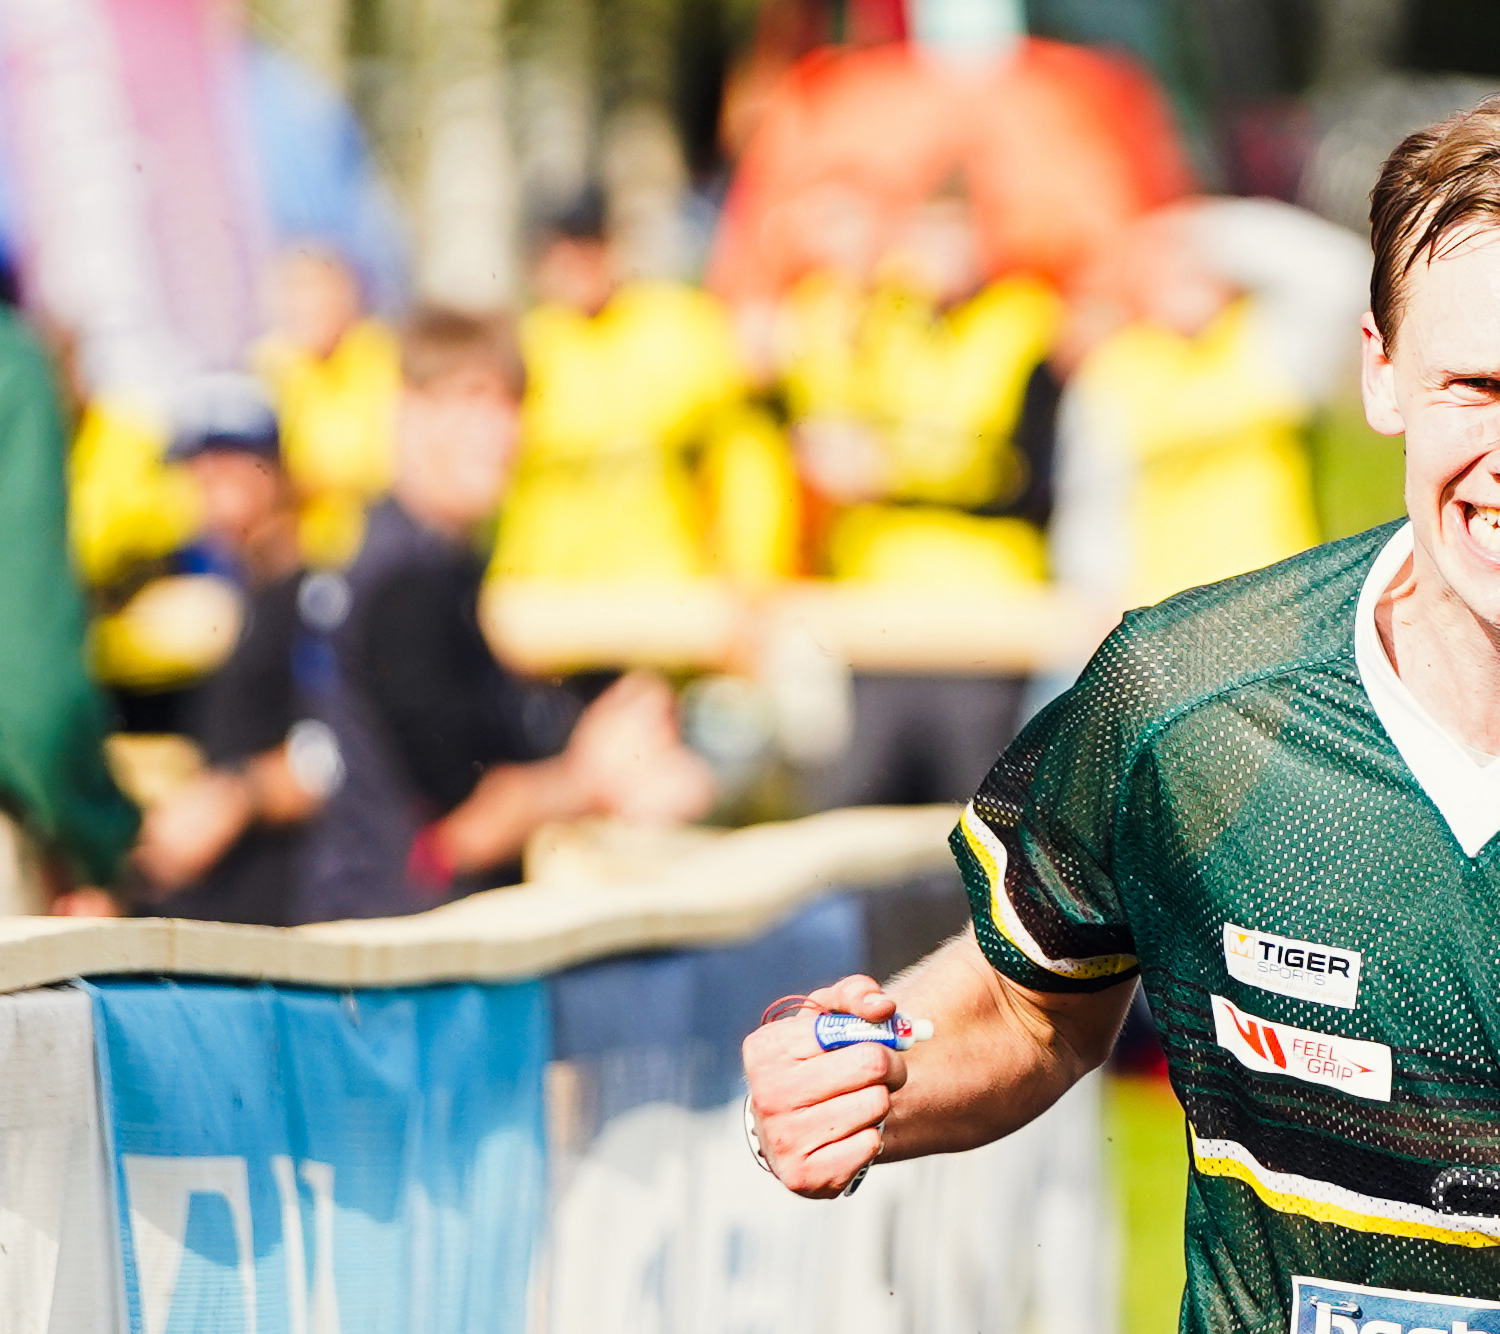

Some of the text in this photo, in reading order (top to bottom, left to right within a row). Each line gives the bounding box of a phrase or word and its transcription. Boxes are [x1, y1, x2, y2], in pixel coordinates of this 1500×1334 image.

[1258, 940, 1350, 979] TIGER
[1257, 961, 1326, 986] SPORTS
[1293, 1038, 1339, 1062] FEEL
[1307, 1058, 1353, 1081] GRIP
